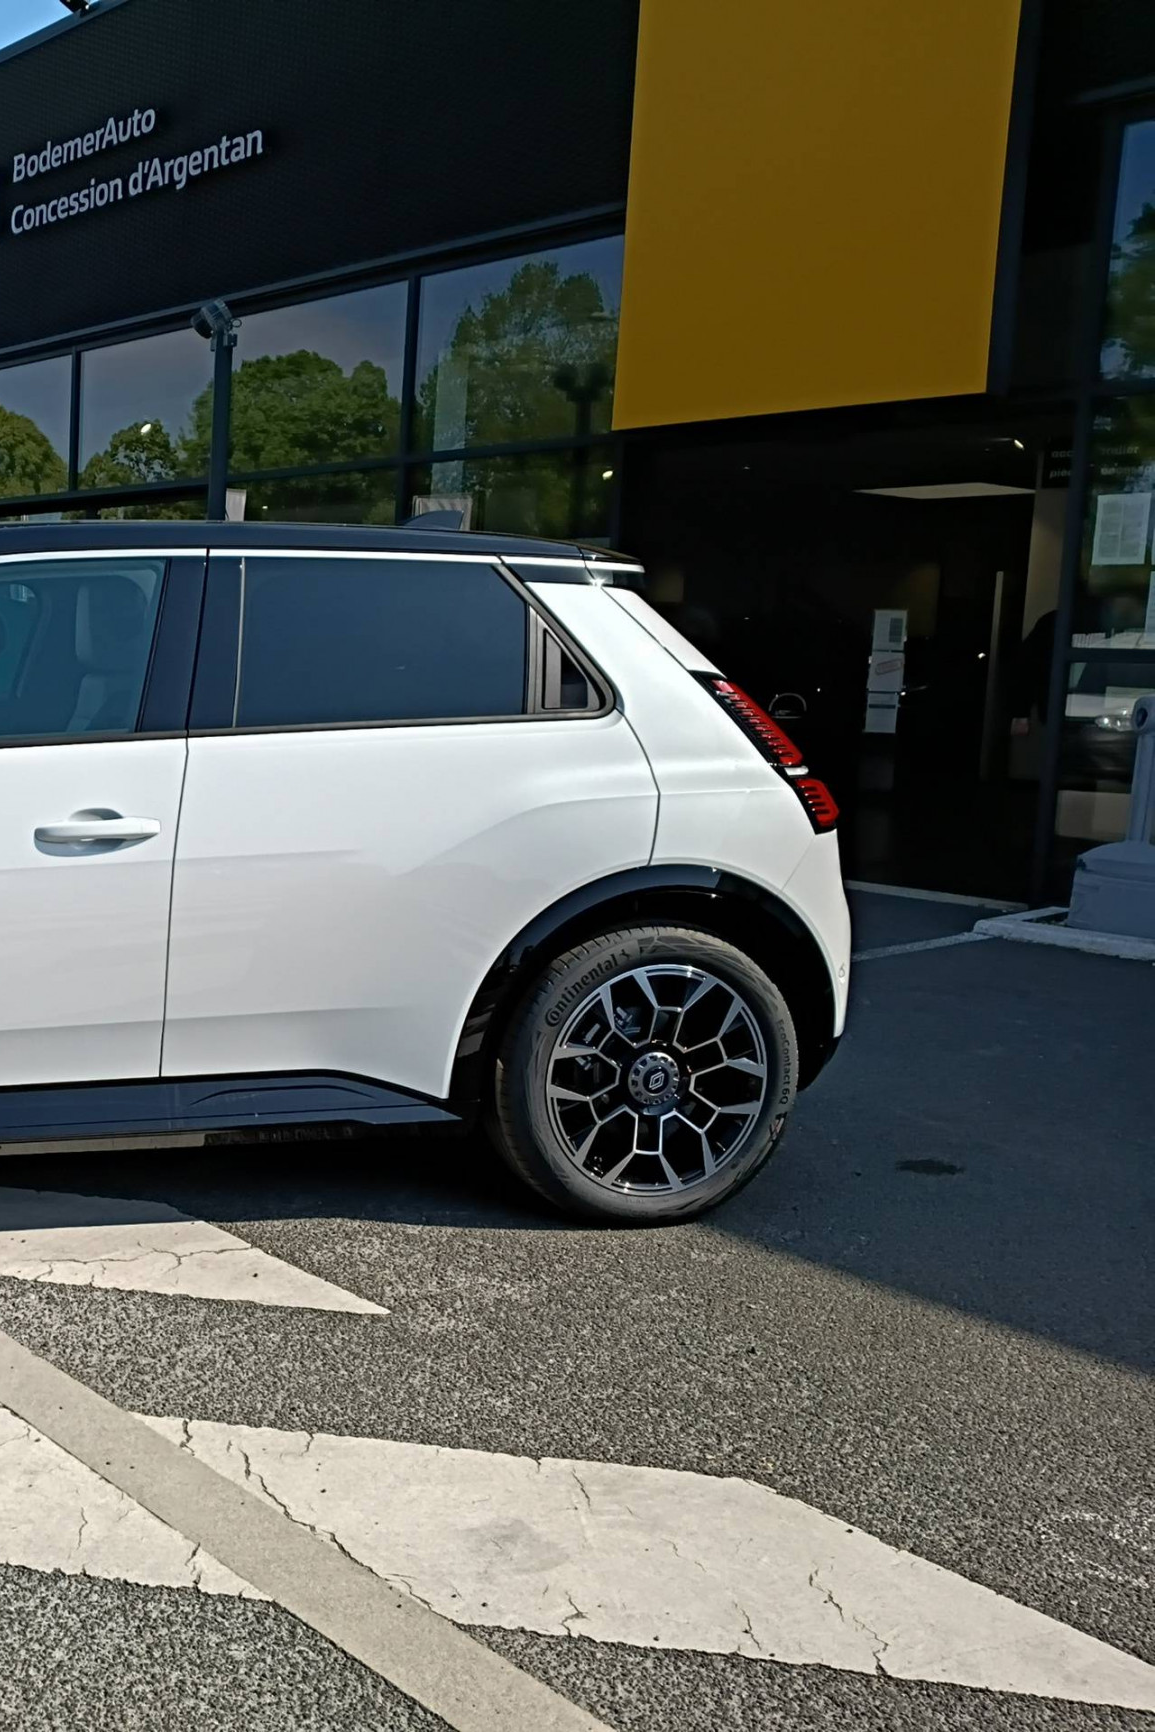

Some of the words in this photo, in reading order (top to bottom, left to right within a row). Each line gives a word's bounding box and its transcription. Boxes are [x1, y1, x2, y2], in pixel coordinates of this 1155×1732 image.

[11, 177, 123, 234] Concession
[128, 129, 264, 197] d'Argentan
[12, 108, 156, 183] BodemerAuto
[545, 952, 619, 1027] Continental
[776, 1018, 792, 1084] EcoContact
